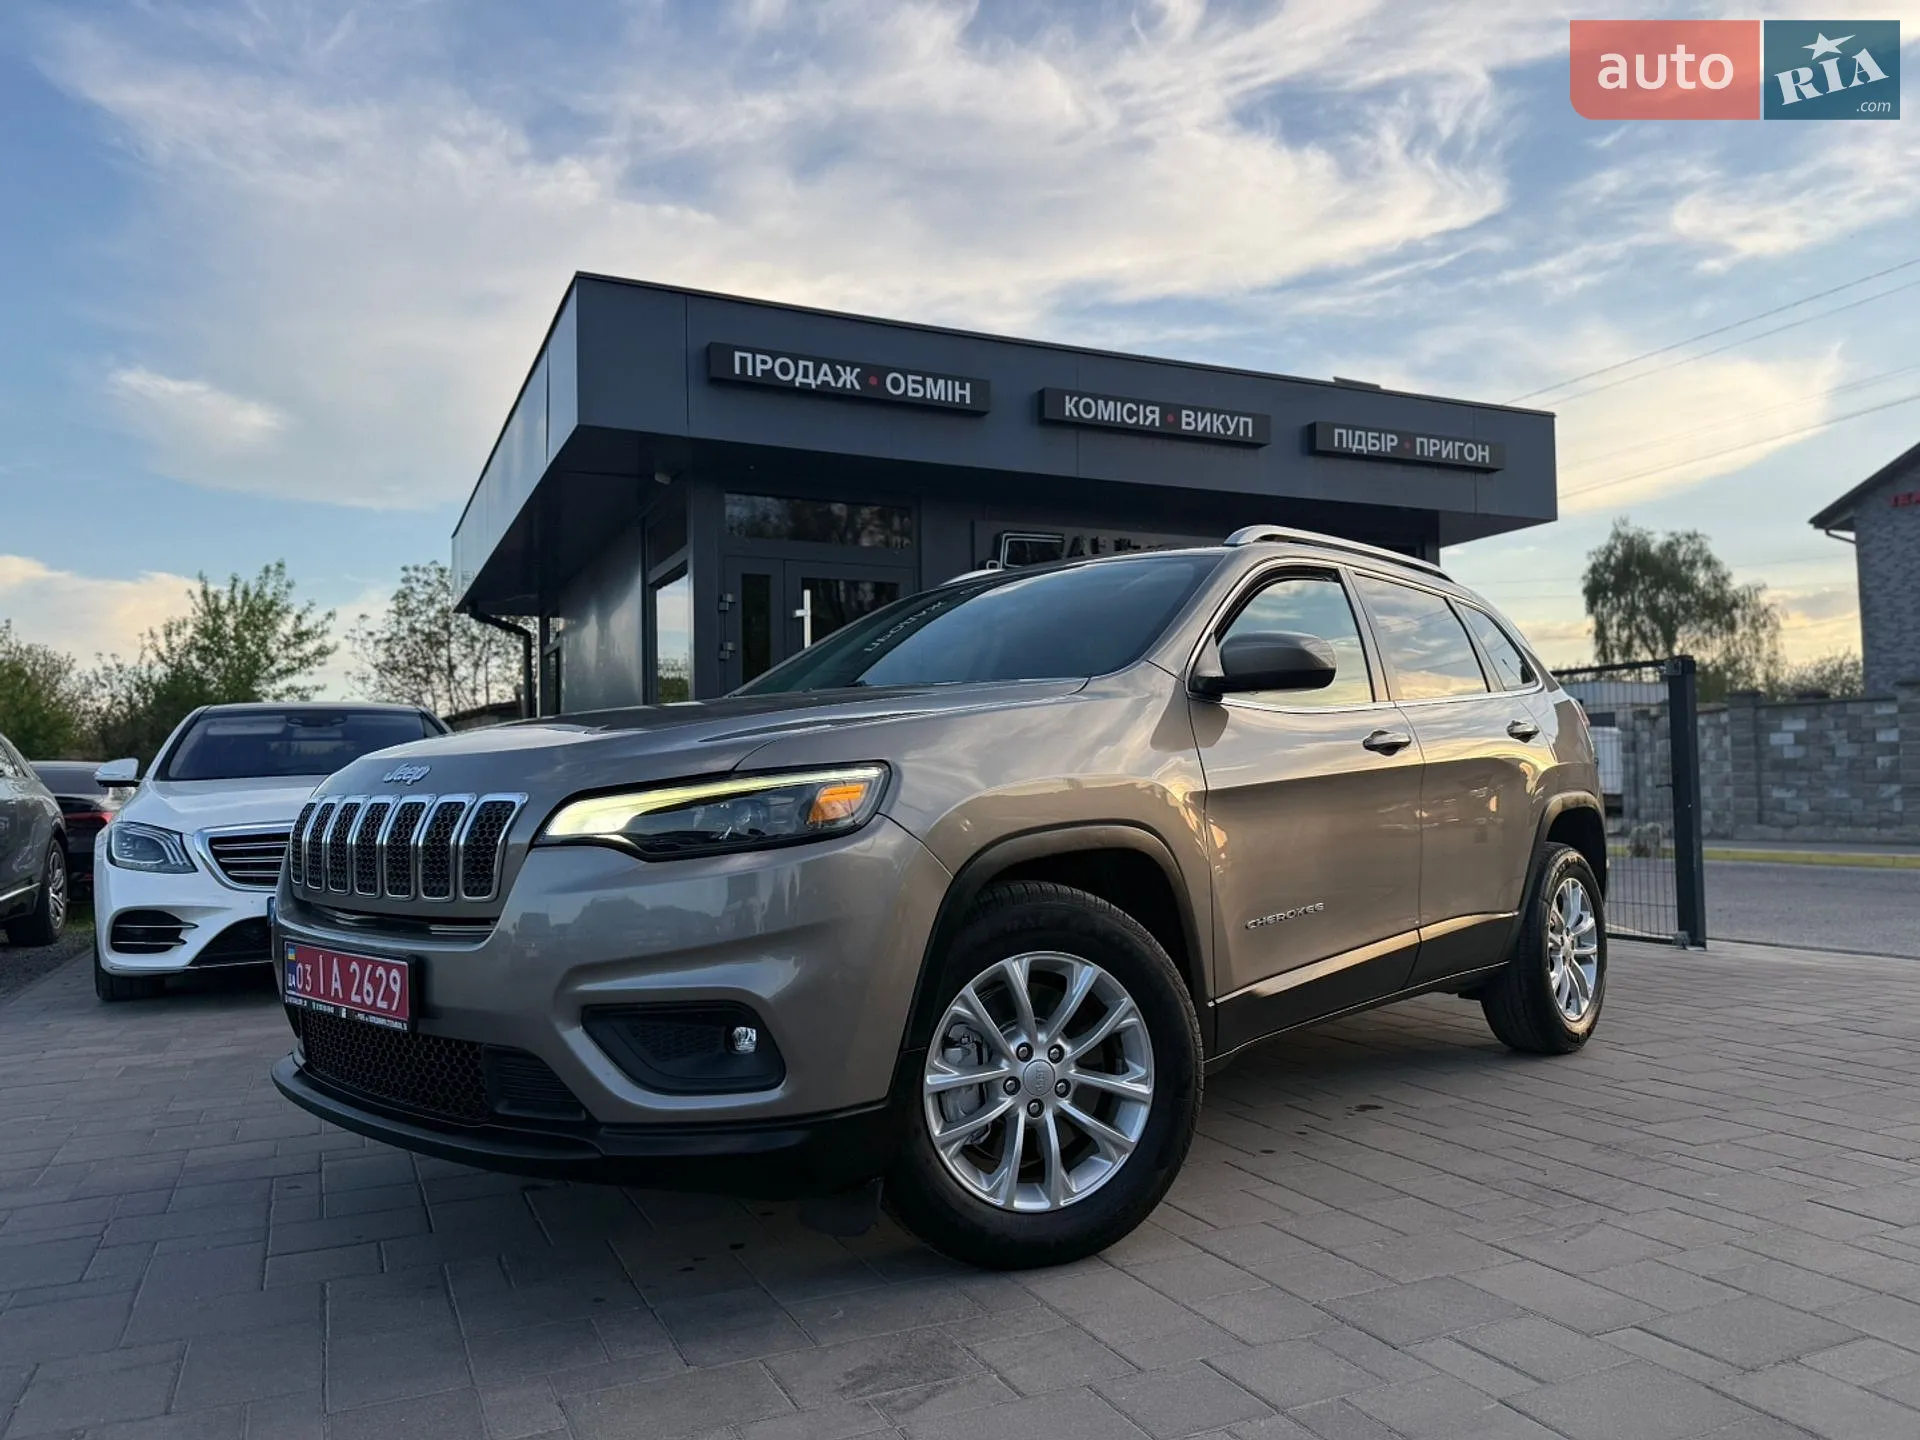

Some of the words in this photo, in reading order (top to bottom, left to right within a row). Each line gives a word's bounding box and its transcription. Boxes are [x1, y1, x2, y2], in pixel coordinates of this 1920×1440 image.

[733, 350, 862, 391] ПРОДАЖ
[885, 371, 972, 405] ОБМІН
[1065, 395, 1161, 428] КОМІСІЯ
[1181, 409, 1254, 438] ВИКУП
[1333, 427, 1399, 455] ПІДБІР
[1415, 436, 1491, 464] ПРИГОН
[382, 762, 432, 786] Jeep
[1245, 902, 1325, 930] CHEROKEE
[349, 960, 402, 1013] 2629
